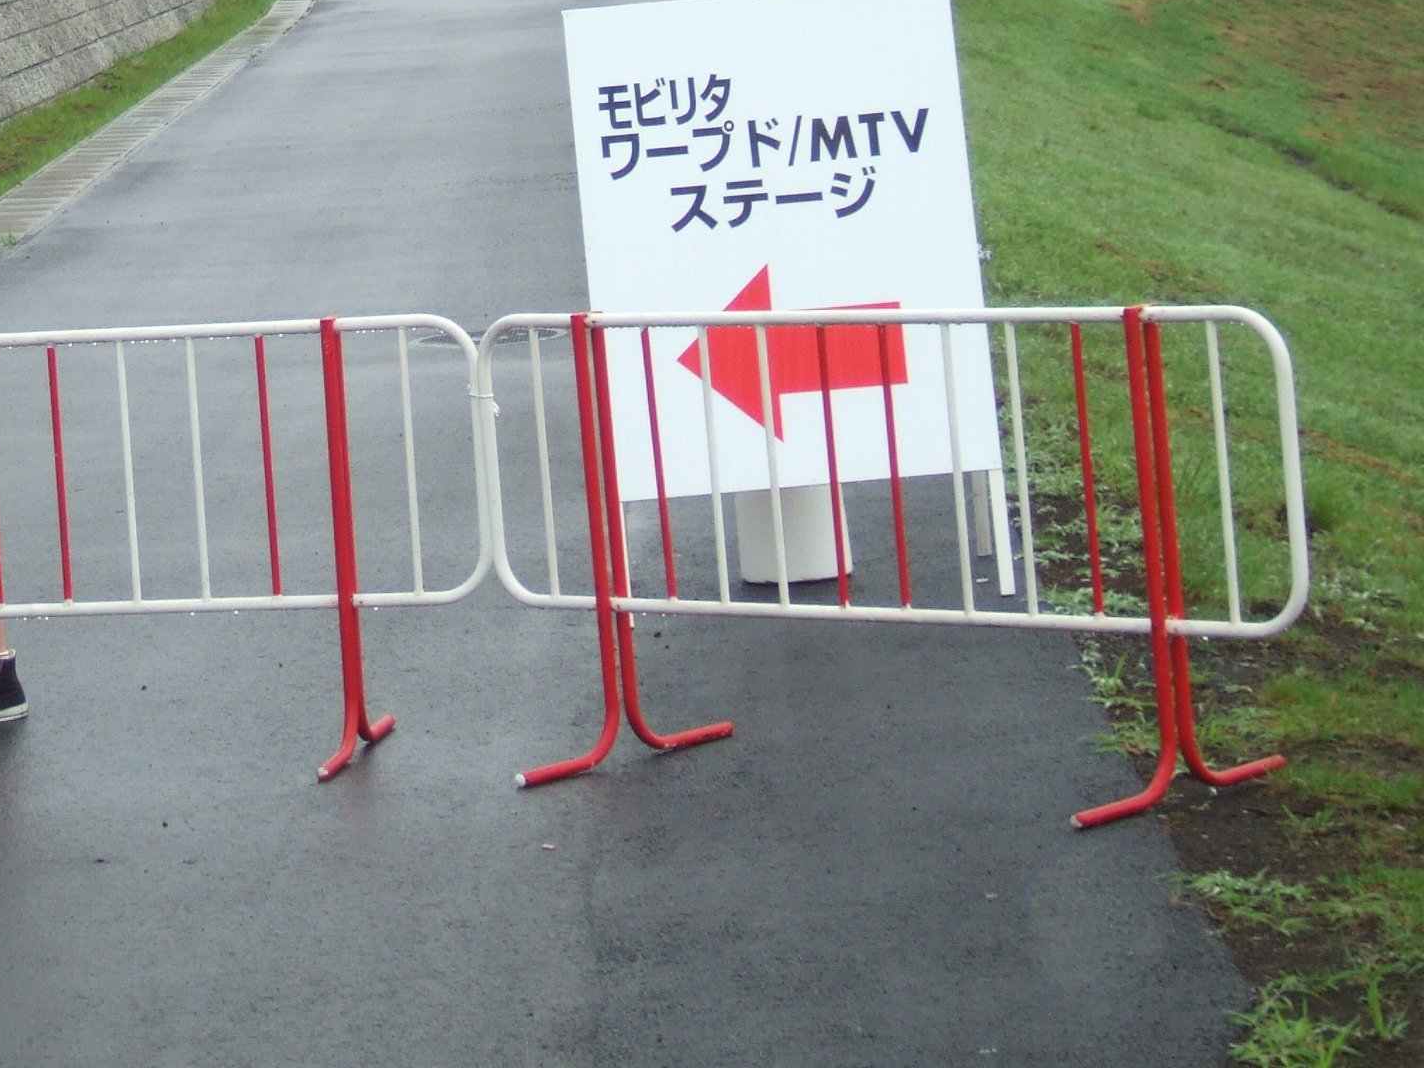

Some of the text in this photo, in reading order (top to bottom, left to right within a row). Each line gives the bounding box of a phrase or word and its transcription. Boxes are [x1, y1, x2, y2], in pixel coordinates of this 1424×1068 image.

[597, 73, 732, 129] モビリタ
[600, 106, 930, 181] ワープド/MTV
[669, 165, 877, 233] ステージ
